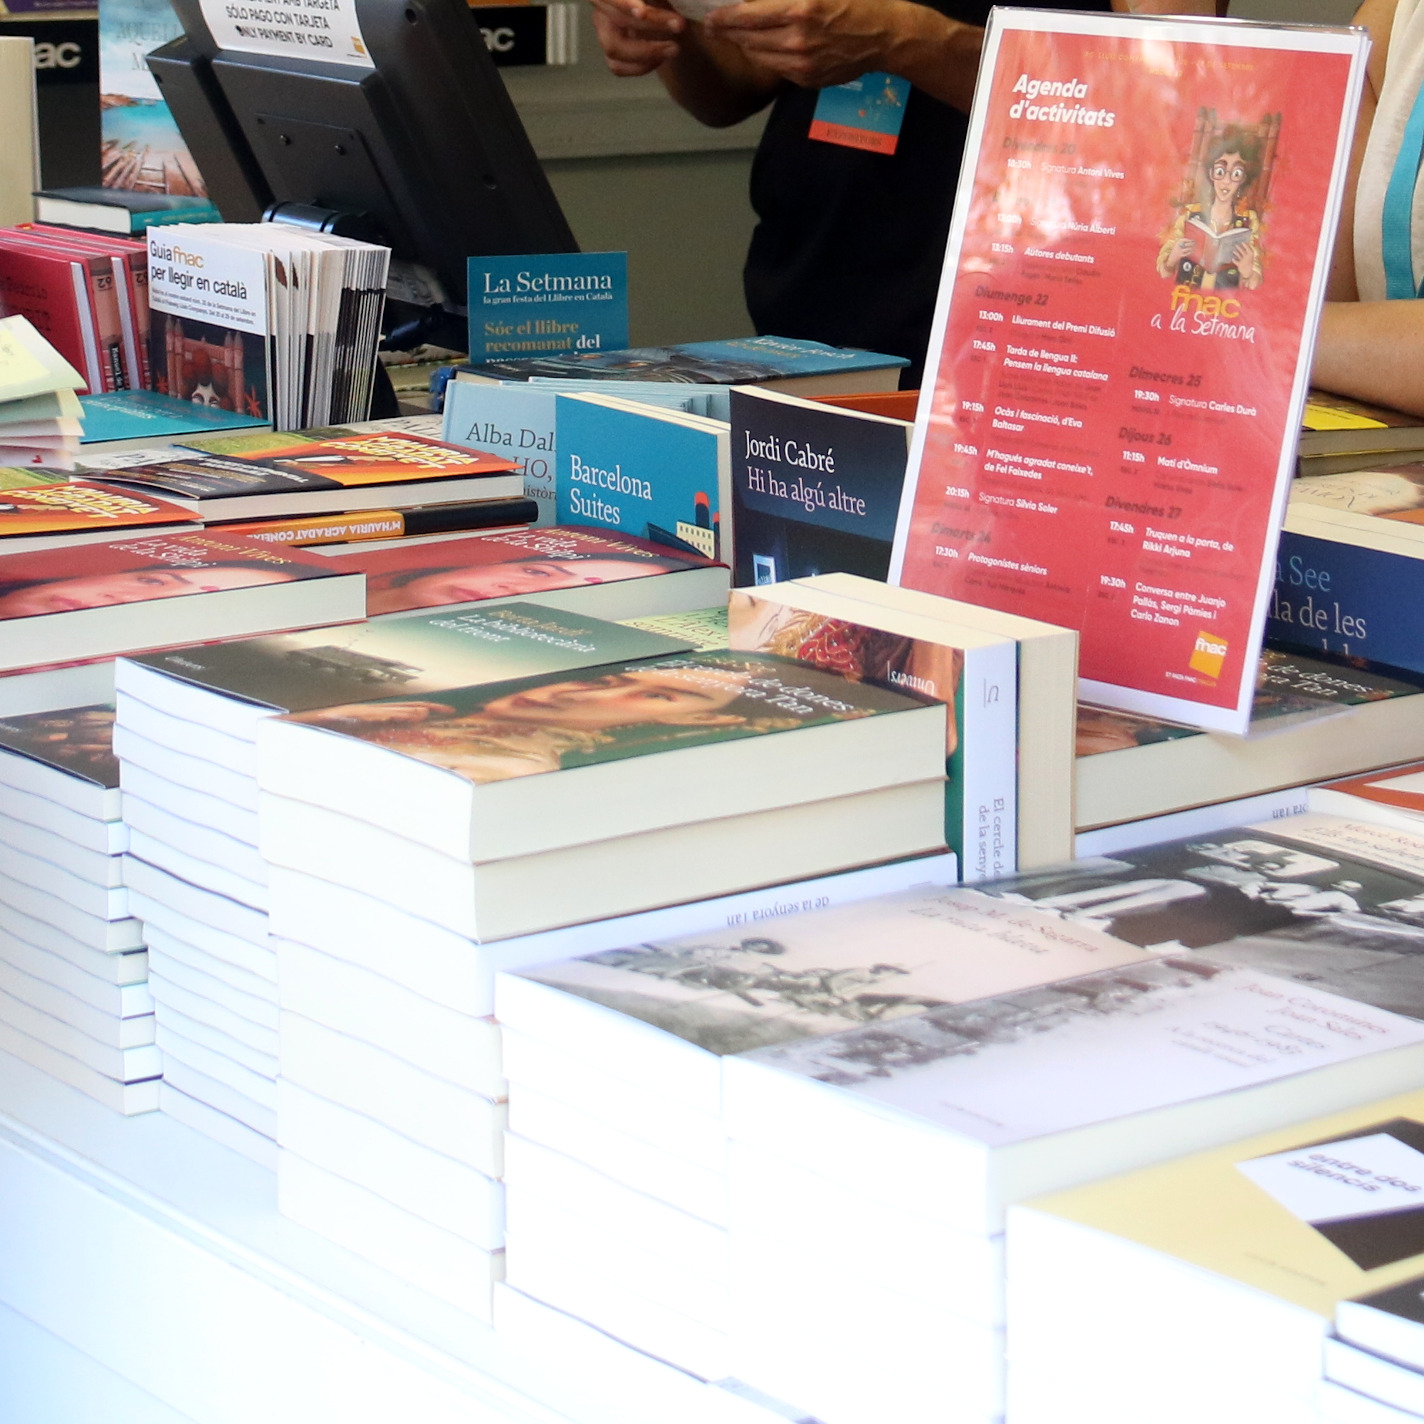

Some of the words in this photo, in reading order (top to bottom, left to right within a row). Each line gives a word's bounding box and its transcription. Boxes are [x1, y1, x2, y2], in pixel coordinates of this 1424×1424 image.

[226, 5, 247, 20] SÓLO
[249, 8, 272, 23] PAGO
[274, 12, 294, 25] CON
[294, 13, 330, 29] TARJETA
[259, 27, 295, 43] PAYMENT
[296, 32, 307, 44] BY
[307, 34, 334, 48] CARD
[1013, 74, 1089, 100] Agenda
[1009, 100, 1116, 127] d'activitats
[150, 240, 173, 262] Guia
[173, 245, 205, 269] fnac
[1024, 246, 1054, 260] Autores
[1055, 250, 1095, 264] debutants
[151, 265, 166, 282] per
[168, 267, 194, 290] llegir
[196, 277, 210, 292] en
[213, 280, 248, 300] català
[483, 272, 511, 294] La
[516, 271, 613, 293] Setmana
[483, 295, 491, 305] la
[492, 295, 511, 306] gran
[513, 294, 533, 304] festa
[534, 294, 547, 304] del
[548, 293, 574, 303] Llibre
[586, 292, 613, 302] Català
[1171, 285, 1241, 319] fnac
[484, 320, 513, 336] Sóc
[516, 321, 532, 336] el
[534, 320, 579, 335] llibre
[1151, 313, 1161, 328] a
[1169, 303, 1185, 333] la
[1191, 311, 1255, 343] Setmana
[484, 337, 572, 353] recomanat
[576, 334, 601, 350] del
[1169, 395, 1208, 410] Signatura
[1209, 400, 1235, 413] Carles
[1236, 405, 1257, 416] Durà
[465, 422, 514, 447] Alba
[518, 428, 555, 453] Dal
[744, 430, 781, 464] Jordi
[784, 441, 836, 474] Cabré
[570, 454, 653, 501] Barcelona
[748, 467, 766, 493] Hi
[769, 471, 788, 498] ha
[791, 480, 825, 509] algú
[828, 487, 867, 517] altre
[979, 492, 1015, 507] Signatura
[1037, 502, 1058, 514] Soler
[570, 488, 621, 526] Suites
[968, 552, 1019, 571] Protagonistes
[1020, 562, 1048, 576] sèniors
[1290, 555, 1331, 592] See
[1135, 582, 1174, 598] Conversa
[1174, 589, 1197, 602] entre
[1198, 593, 1226, 609] Juanjo
[1299, 596, 1328, 631] de
[1334, 601, 1367, 639] les
[1195, 636, 1228, 656] fnac
[1287, 1159, 1382, 1194] silencis
[1307, 1152, 1373, 1176] entre
[1374, 1175, 1422, 1193] dos
